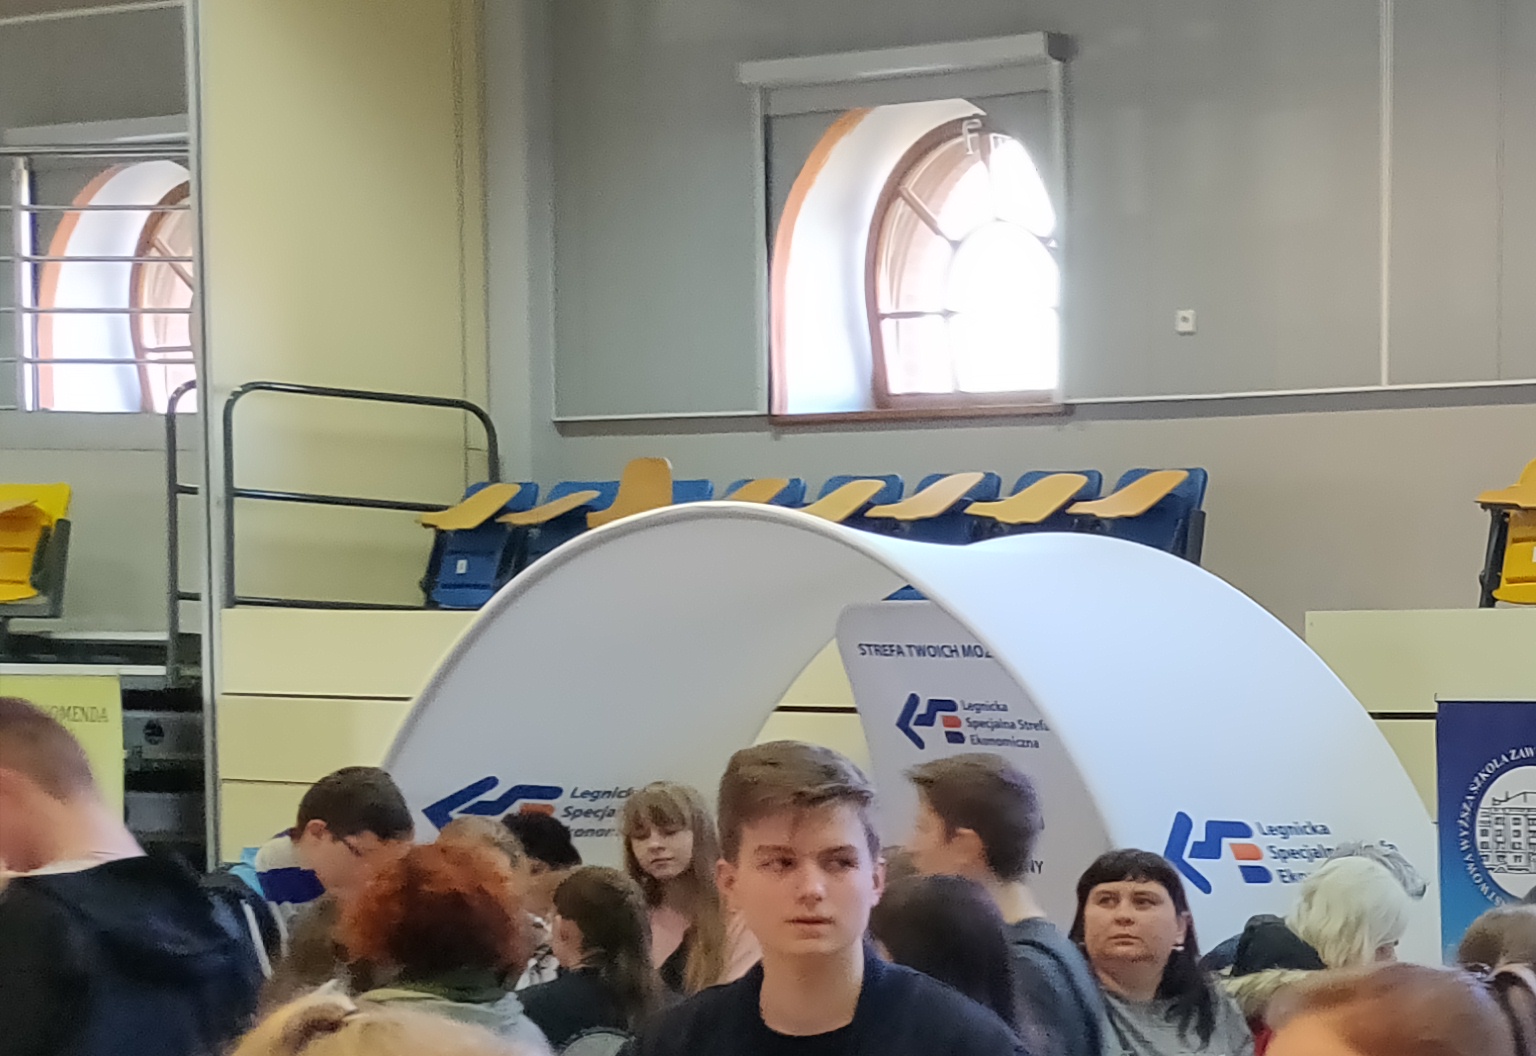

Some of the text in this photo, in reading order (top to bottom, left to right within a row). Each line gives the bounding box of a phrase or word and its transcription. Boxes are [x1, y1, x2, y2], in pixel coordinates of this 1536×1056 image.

[858, 643, 908, 657] STREFA
[908, 644, 960, 658] TWOICH
[963, 701, 1008, 714] Legnicka
[561, 806, 616, 821] Specja
[1256, 823, 1332, 839] Legnicka
